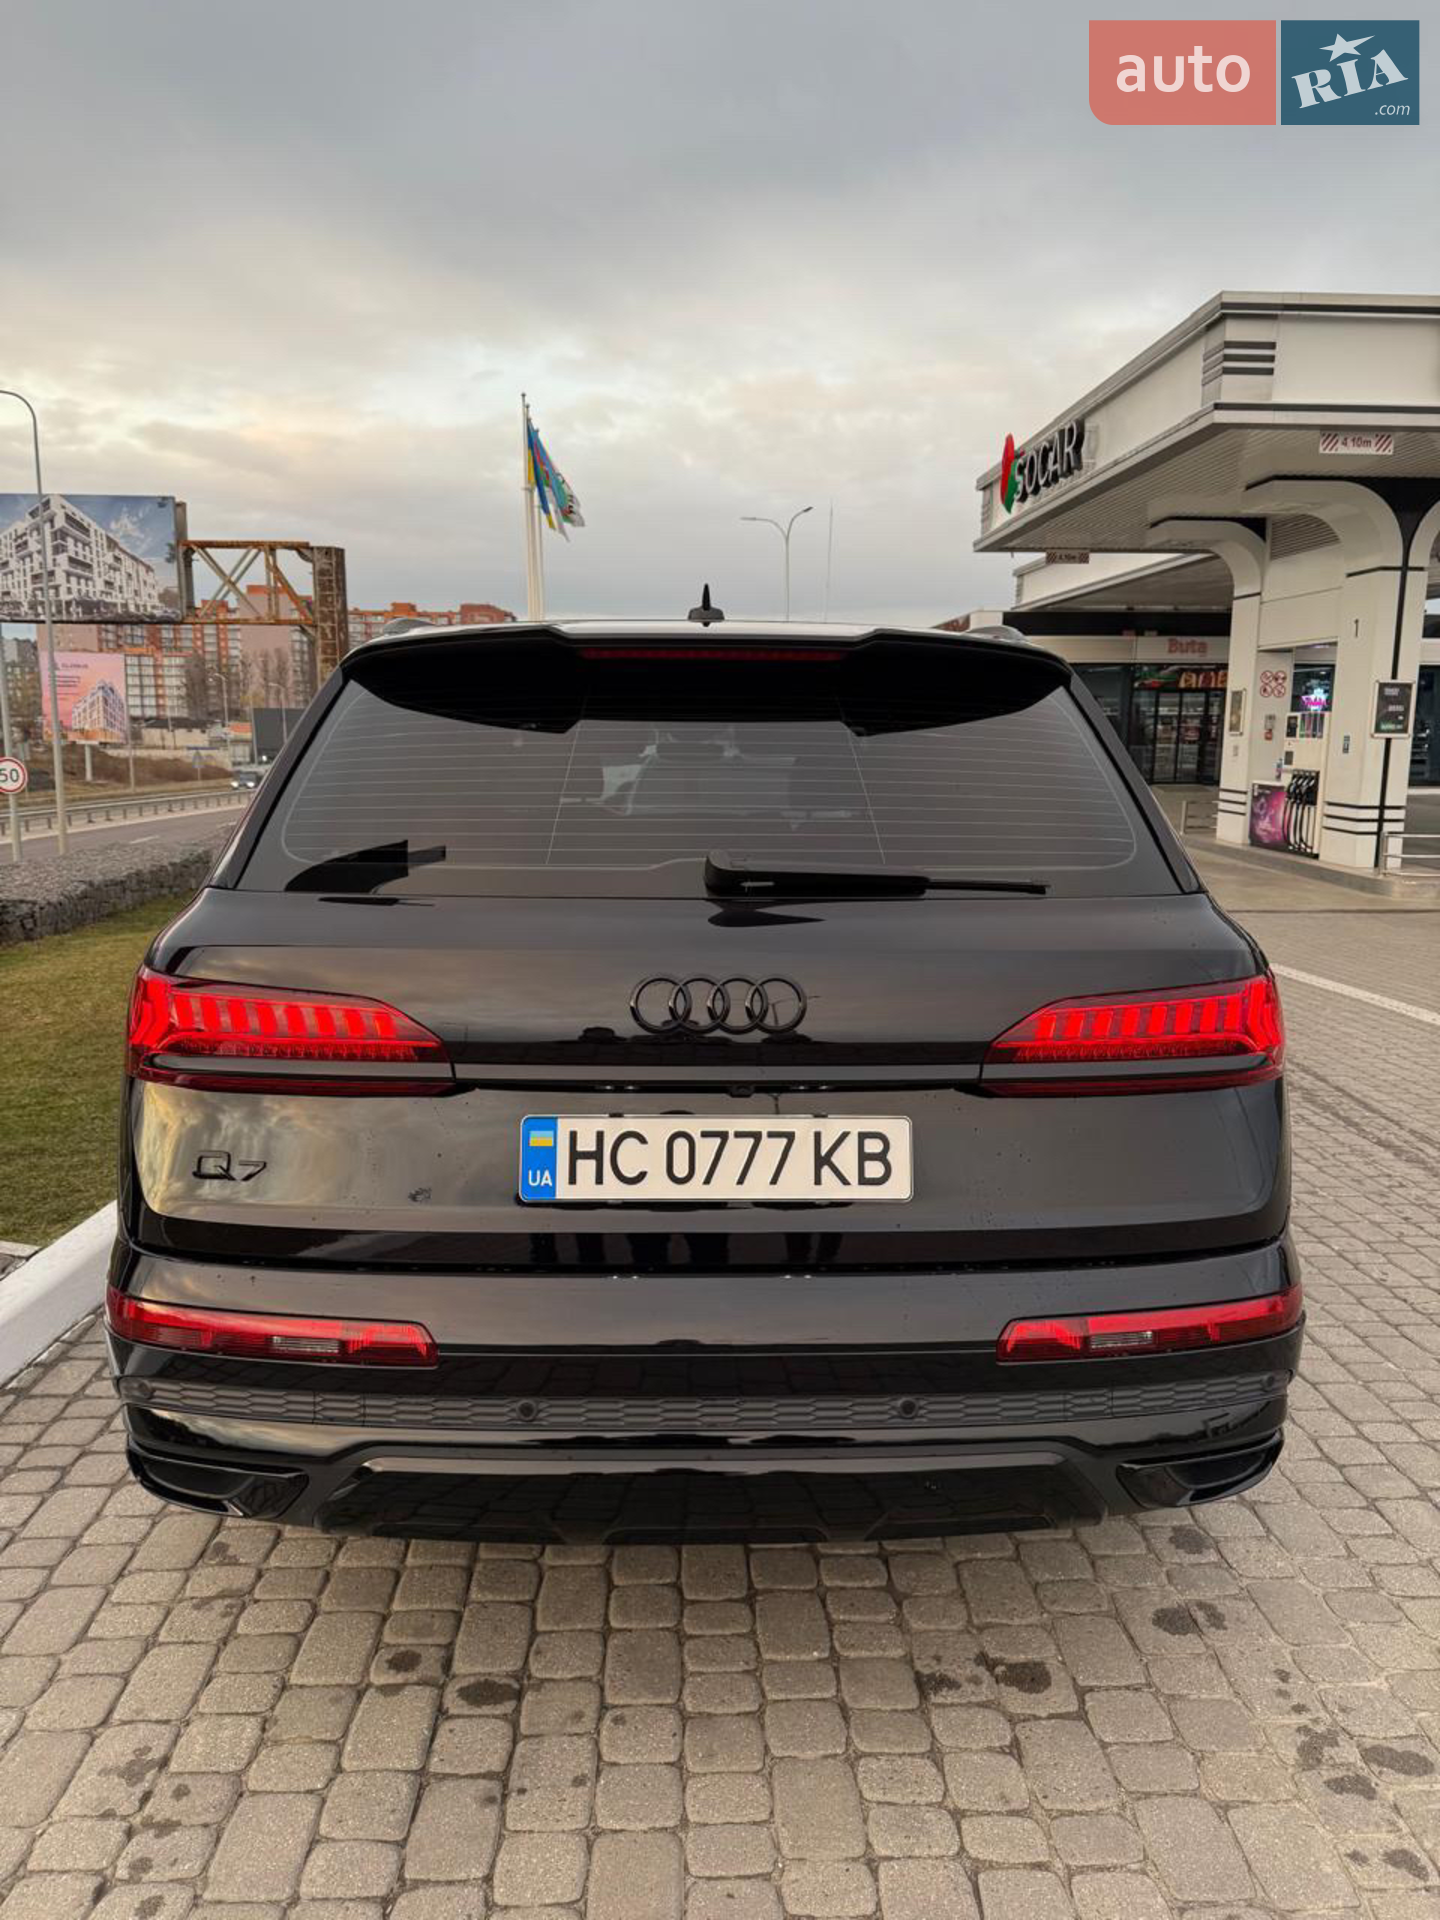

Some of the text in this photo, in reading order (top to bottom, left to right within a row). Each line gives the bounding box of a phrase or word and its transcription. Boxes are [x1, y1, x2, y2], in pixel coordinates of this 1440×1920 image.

[1014, 419, 1080, 501] SOCAR
[1354, 618, 1359, 638] 1
[0, 768, 19, 783] 50
[192, 1149, 267, 1181] Q7
[568, 1130, 893, 1186] HC 0777 KB
[528, 1169, 553, 1187] UA
